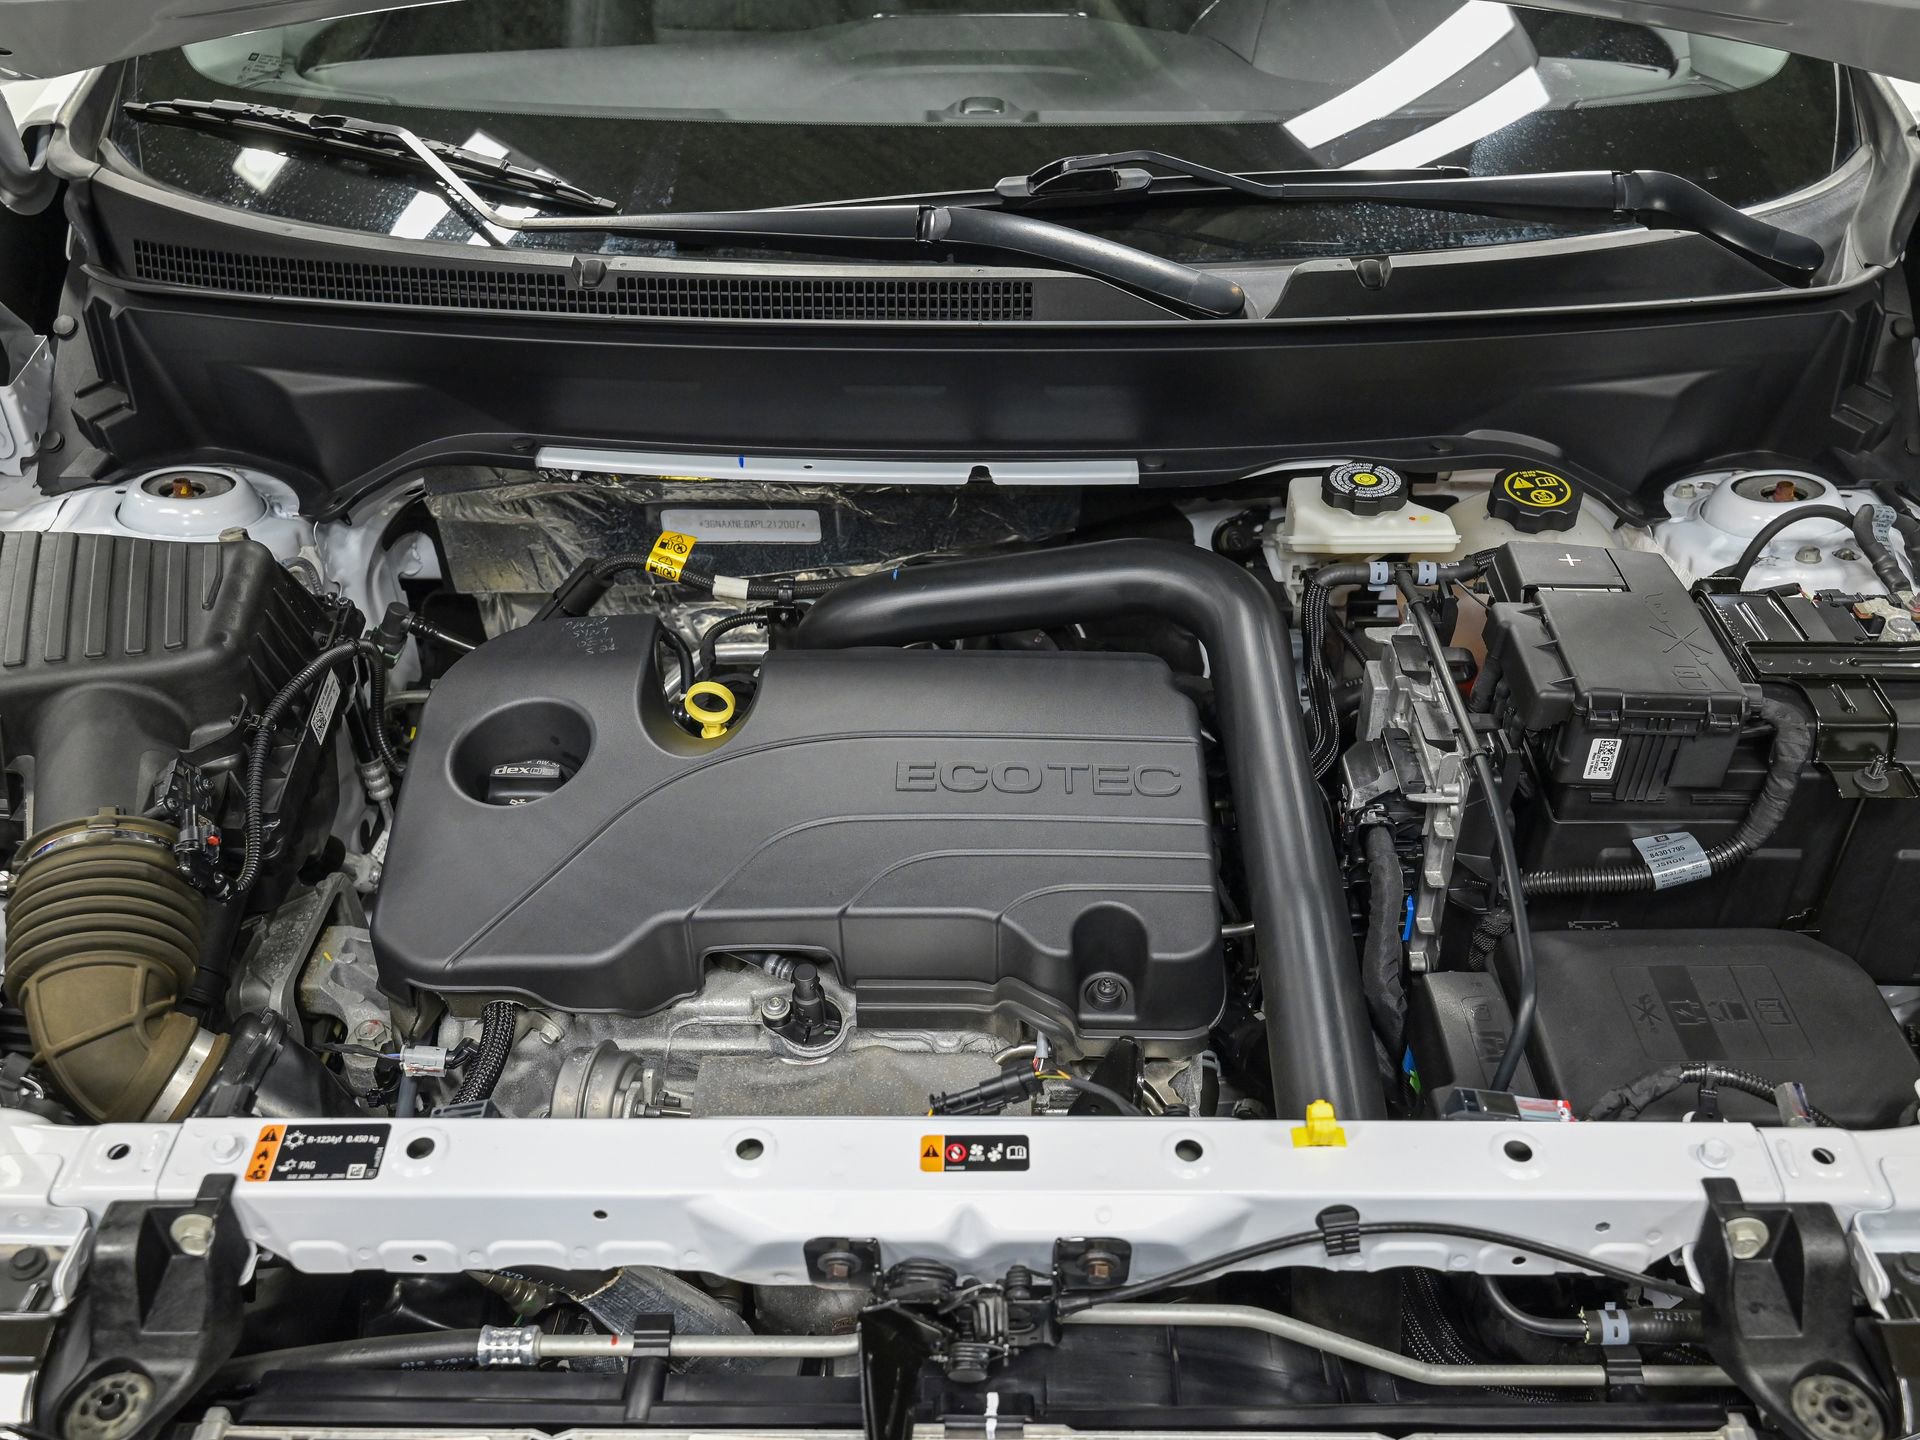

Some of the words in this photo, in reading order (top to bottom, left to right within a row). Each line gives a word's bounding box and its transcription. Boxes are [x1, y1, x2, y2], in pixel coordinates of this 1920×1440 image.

[1598, 756, 1610, 771] GPC
[895, 760, 1182, 797] ECOTEC
[298, 1160, 316, 1169] PAG
